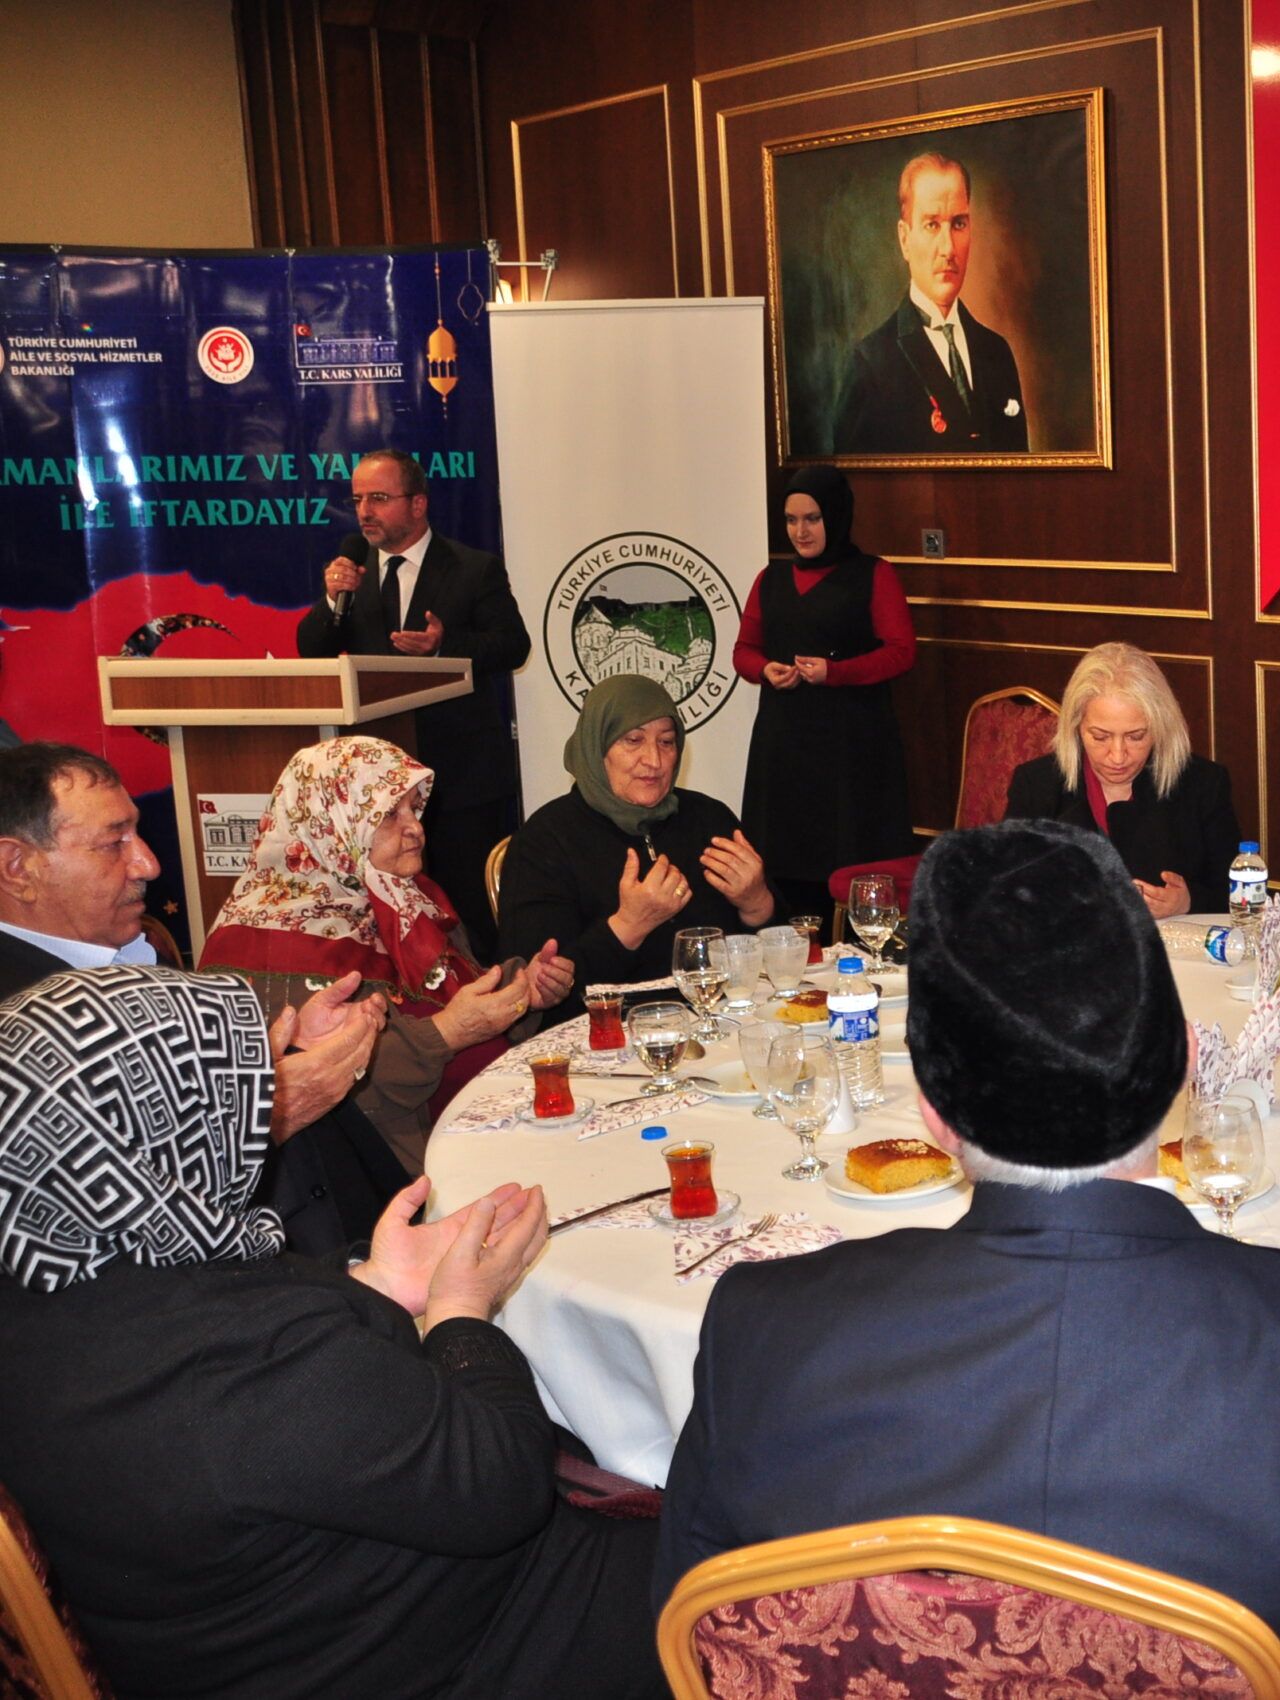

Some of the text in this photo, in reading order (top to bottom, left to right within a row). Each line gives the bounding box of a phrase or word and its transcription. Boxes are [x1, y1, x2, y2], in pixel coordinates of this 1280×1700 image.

[8, 336, 138, 349] TÜRKİYE CUMHURİYETİ
[10, 351, 163, 363] AİLE VE SOSYAL HİZMETLER
[11, 364, 75, 376] BAKANLIĞI
[299, 369, 320, 380] T.C.
[321, 368, 352, 380] KARS
[256, 453, 299, 481] VE
[60, 495, 115, 530] İLE
[557, 543, 731, 612] TÜRKİYE CUMHURİYETİ
[206, 856, 249, 867] T.C. KA
